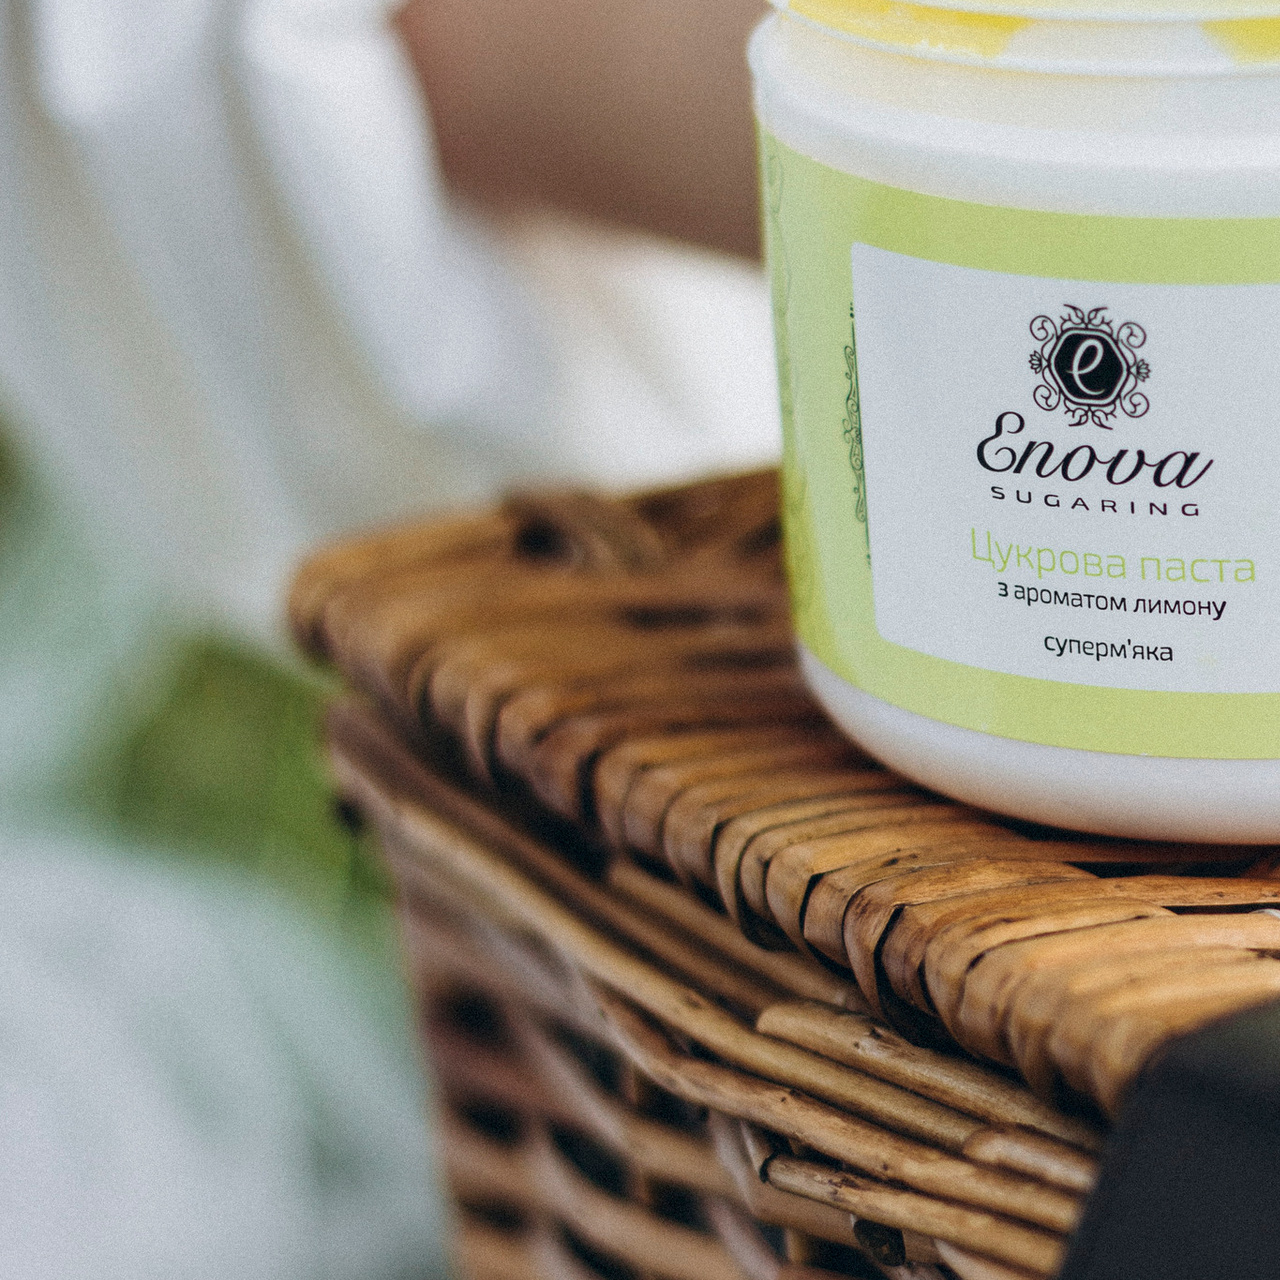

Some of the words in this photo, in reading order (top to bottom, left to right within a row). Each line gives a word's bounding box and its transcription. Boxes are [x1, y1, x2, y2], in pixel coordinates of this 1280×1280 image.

[976, 410, 1215, 490] Enova
[990, 485, 1200, 517] SUGARING
[970, 527, 1127, 580] Цукрова
[1139, 556, 1257, 583] паста
[997, 581, 1009, 597] з
[1013, 584, 1127, 613] ароматом
[1133, 597, 1227, 621] лимону
[1043, 634, 1174, 663] суперм'яка
